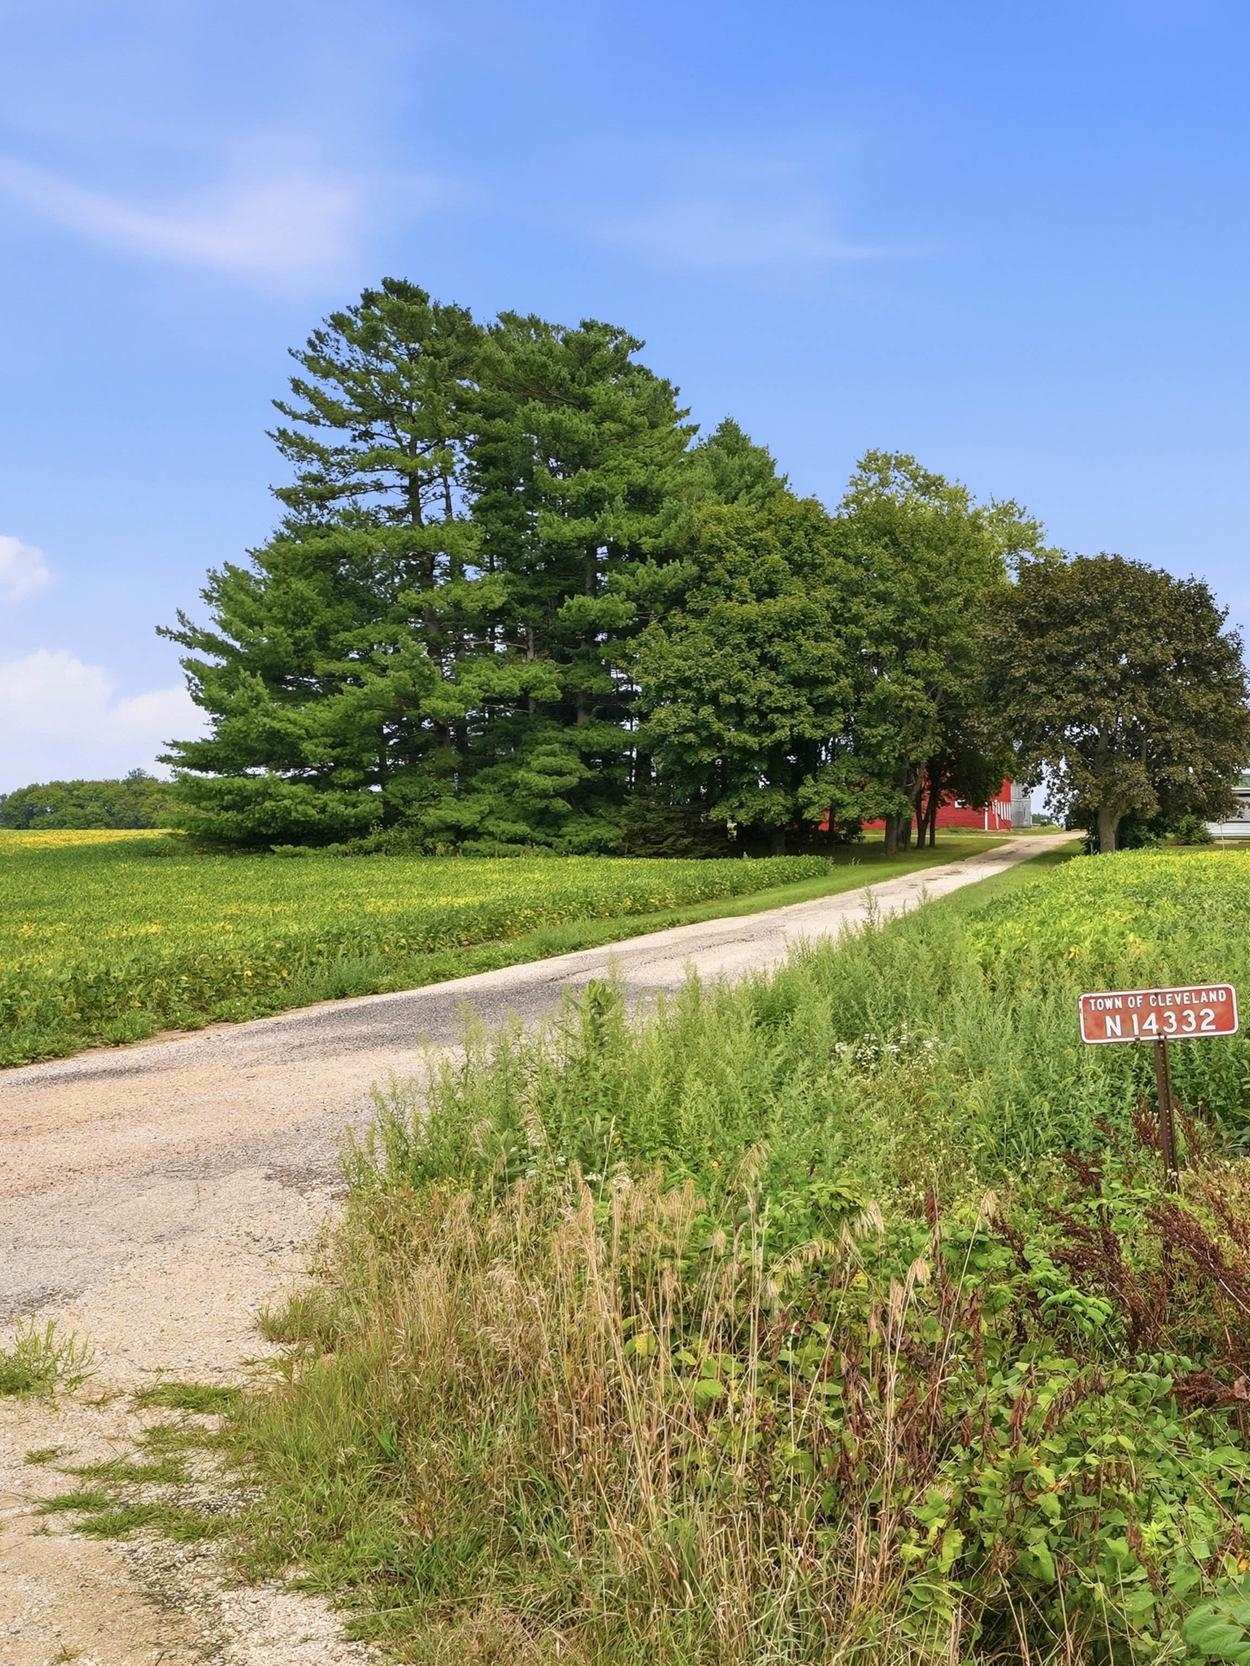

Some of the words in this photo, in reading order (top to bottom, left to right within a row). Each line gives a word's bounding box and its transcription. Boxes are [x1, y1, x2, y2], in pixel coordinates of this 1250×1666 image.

[1089, 998, 1122, 1011] TOWN
[1127, 996, 1143, 1008] OF
[1149, 990, 1227, 1007] CLEVELAND
